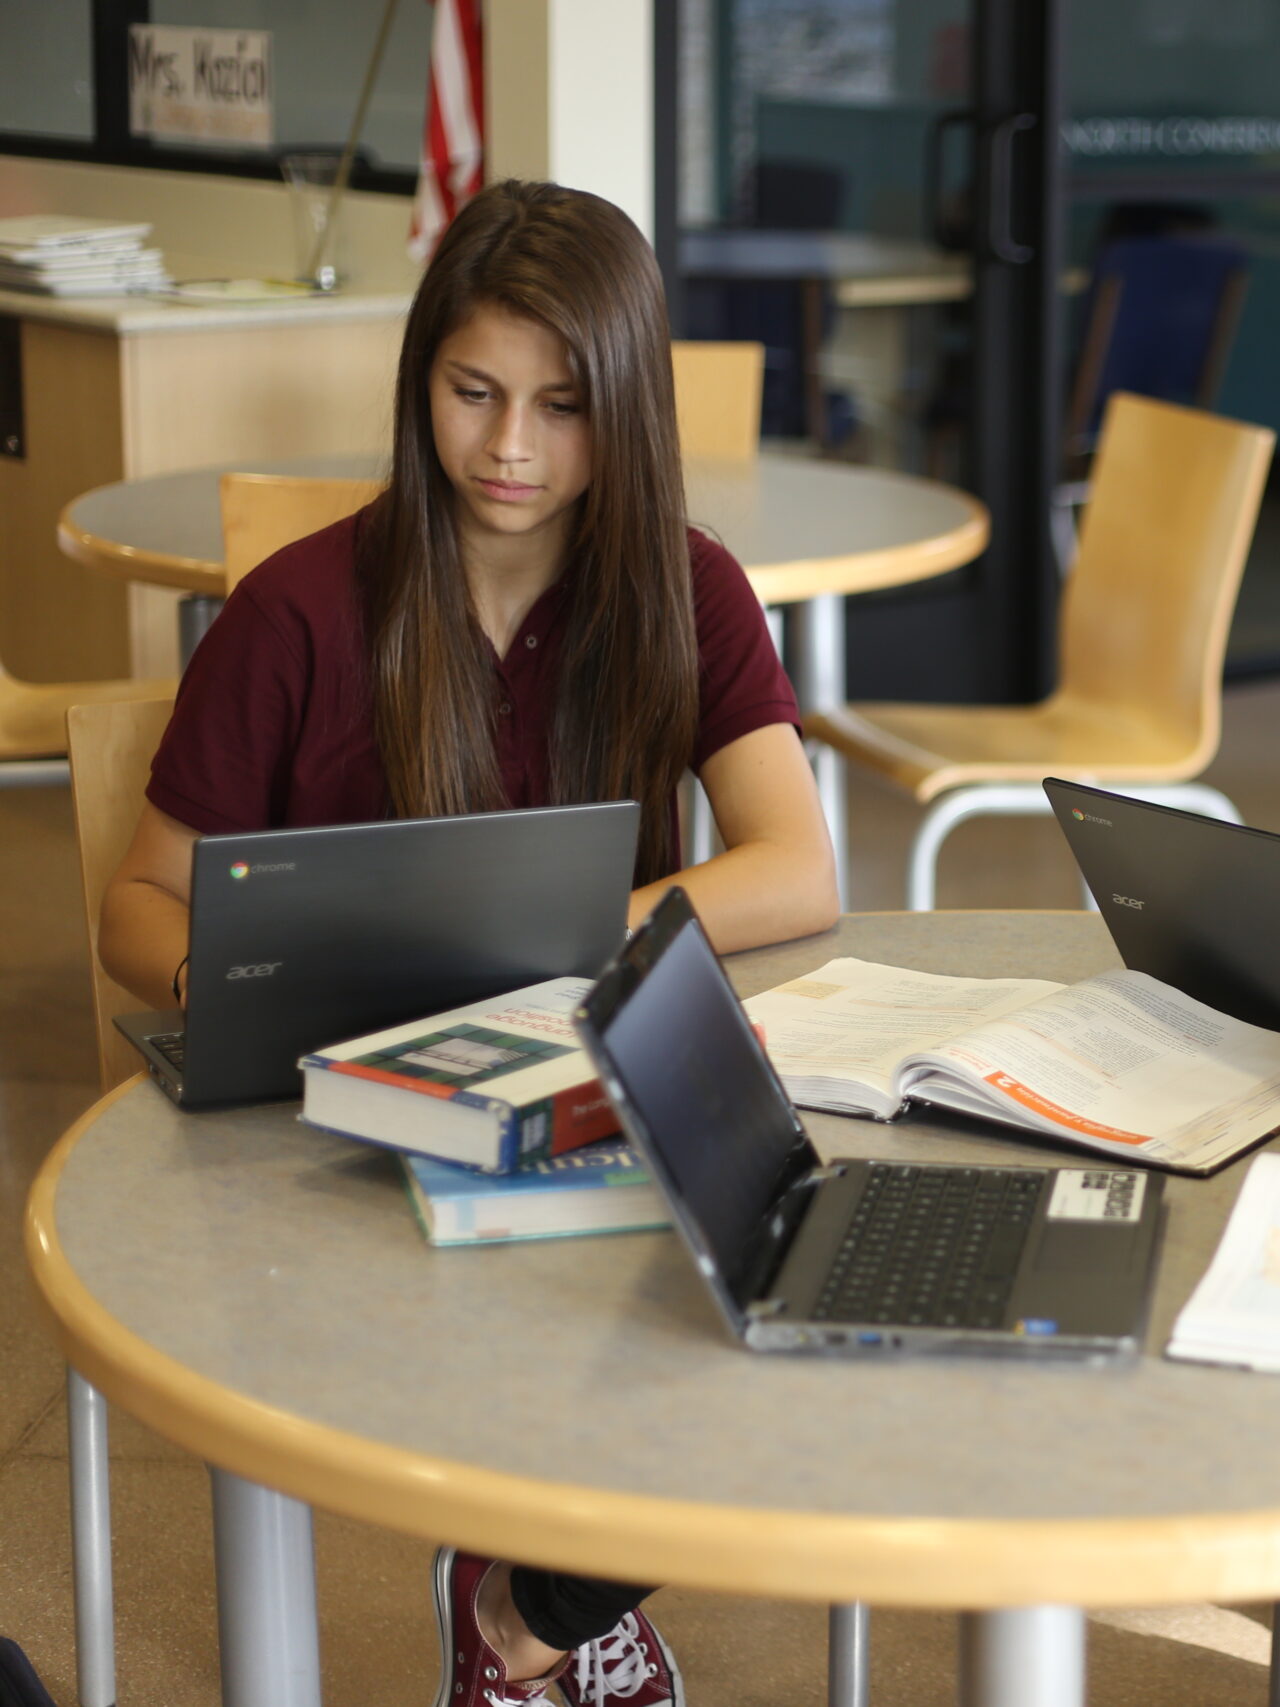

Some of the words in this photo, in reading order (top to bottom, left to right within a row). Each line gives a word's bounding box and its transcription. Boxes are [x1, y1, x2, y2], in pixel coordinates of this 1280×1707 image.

[251, 862, 296, 874] chrome
[1111, 893, 1145, 910] acer
[226, 961, 282, 980] acer
